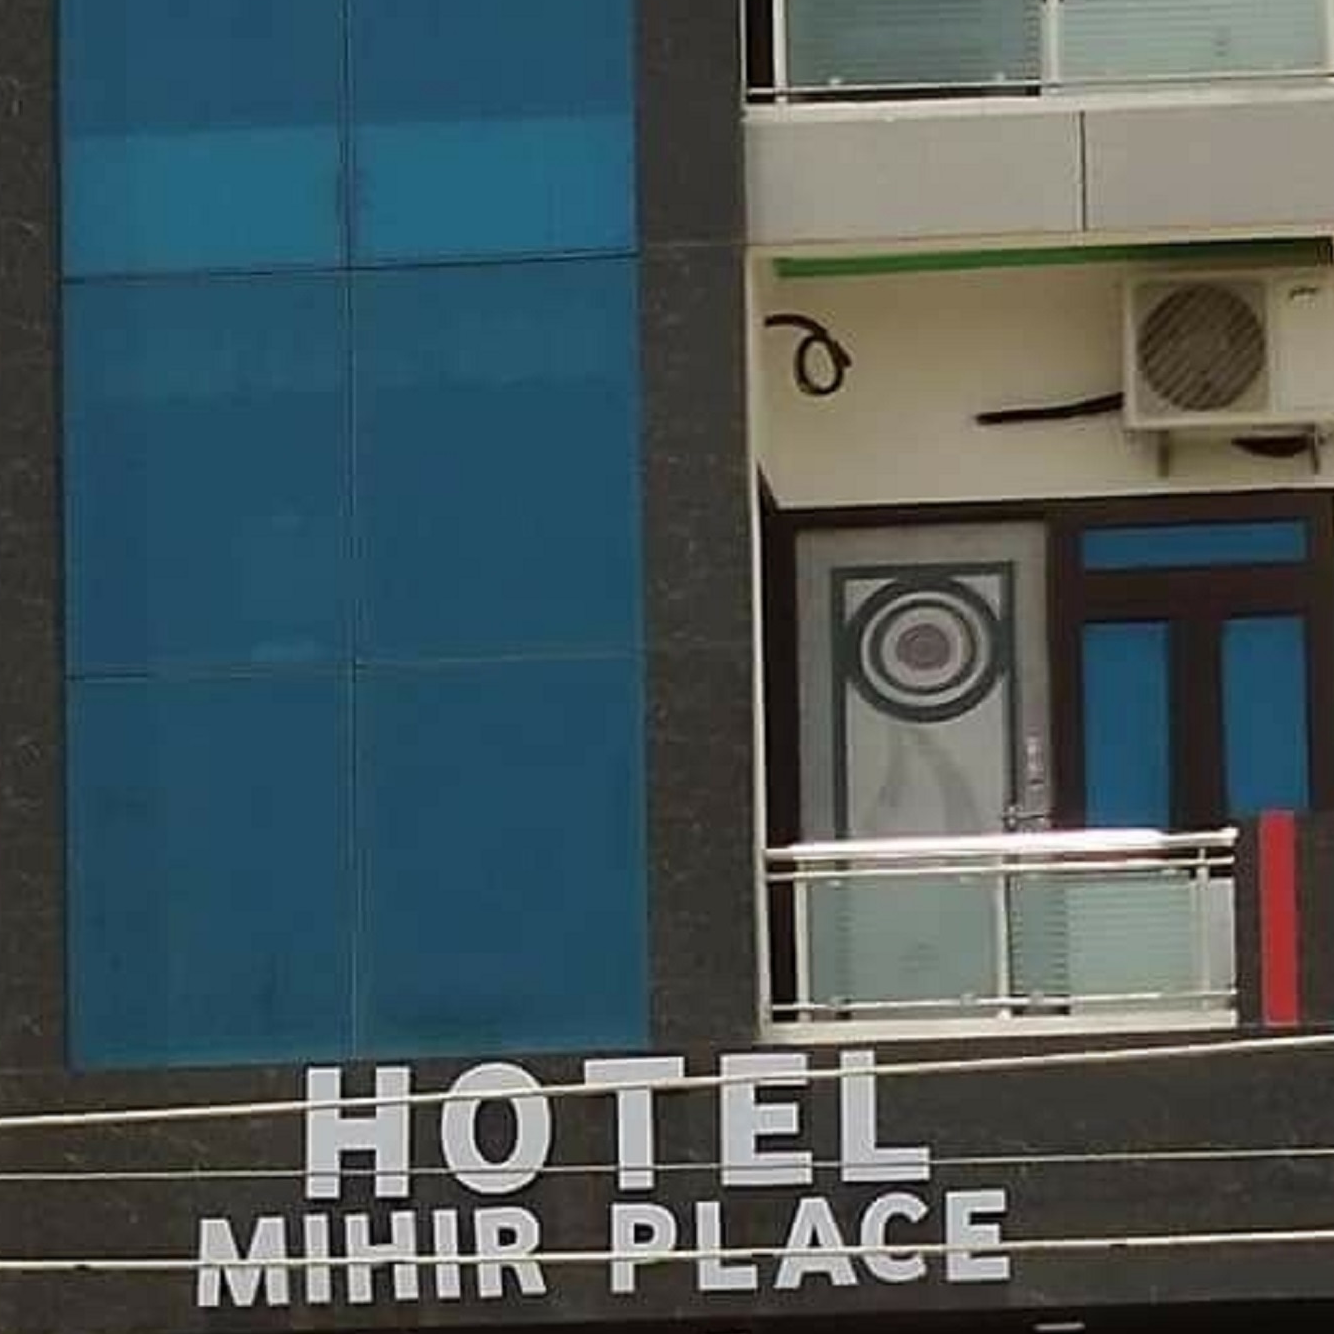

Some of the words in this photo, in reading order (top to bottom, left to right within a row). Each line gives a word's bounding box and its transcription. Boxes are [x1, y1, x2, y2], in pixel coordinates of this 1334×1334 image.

[305, 1049, 931, 1200] HOTEL
[197, 1205, 547, 1307] MIHIR
[610, 1188, 1011, 1294] PLACE
